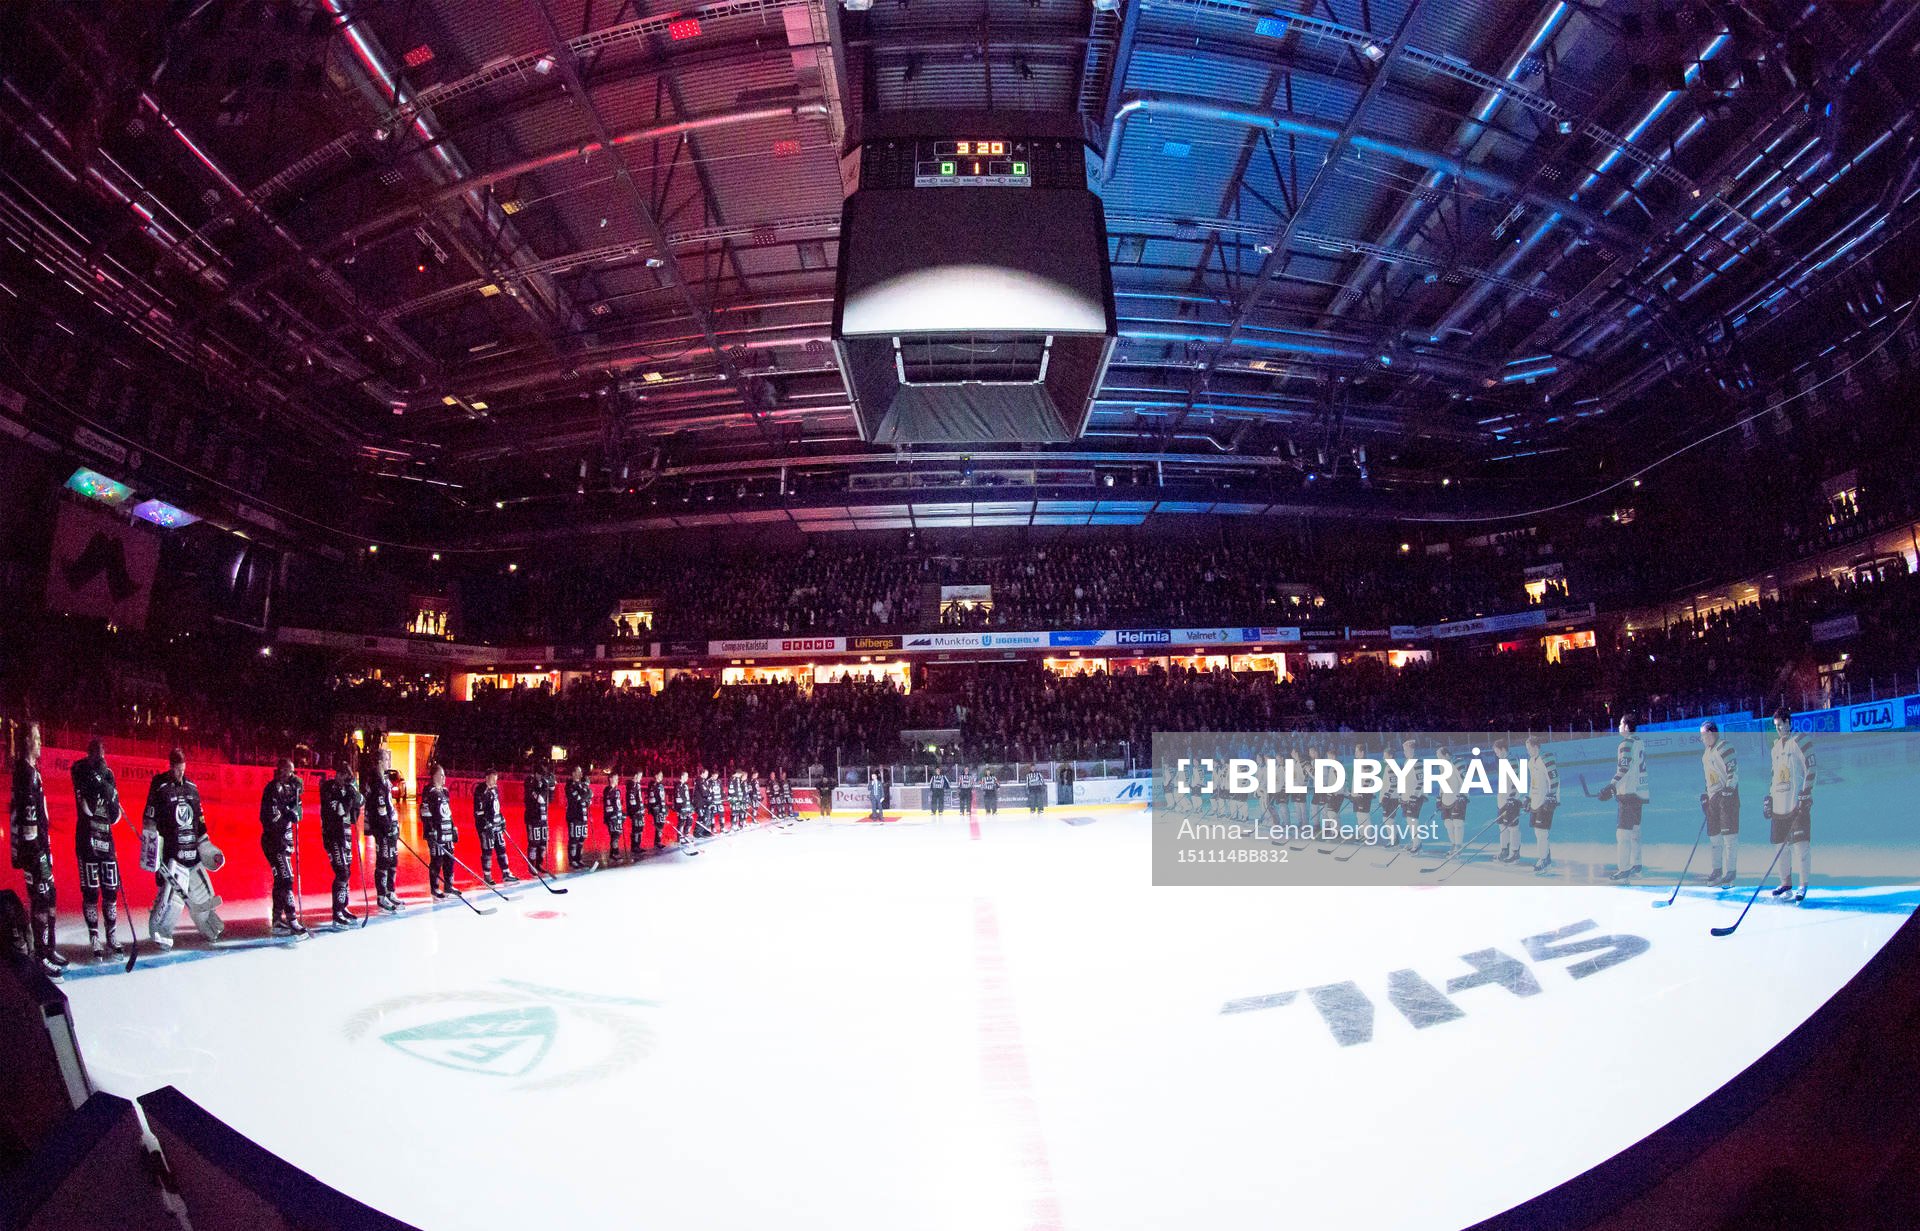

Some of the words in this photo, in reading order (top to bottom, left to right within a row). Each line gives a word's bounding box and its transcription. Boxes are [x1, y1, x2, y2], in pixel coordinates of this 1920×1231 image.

[941, 162, 953, 175] 0
[1013, 162, 1025, 175] 0
[935, 636, 979, 646] Munkfors
[1118, 631, 1169, 643] Helmia
[1186, 631, 1217, 640] Valmet
[855, 638, 893, 649] Löfbergs
[1907, 705, 1920, 717] SW
[1853, 707, 1892, 728] JULA
[836, 790, 870, 802] Peters
